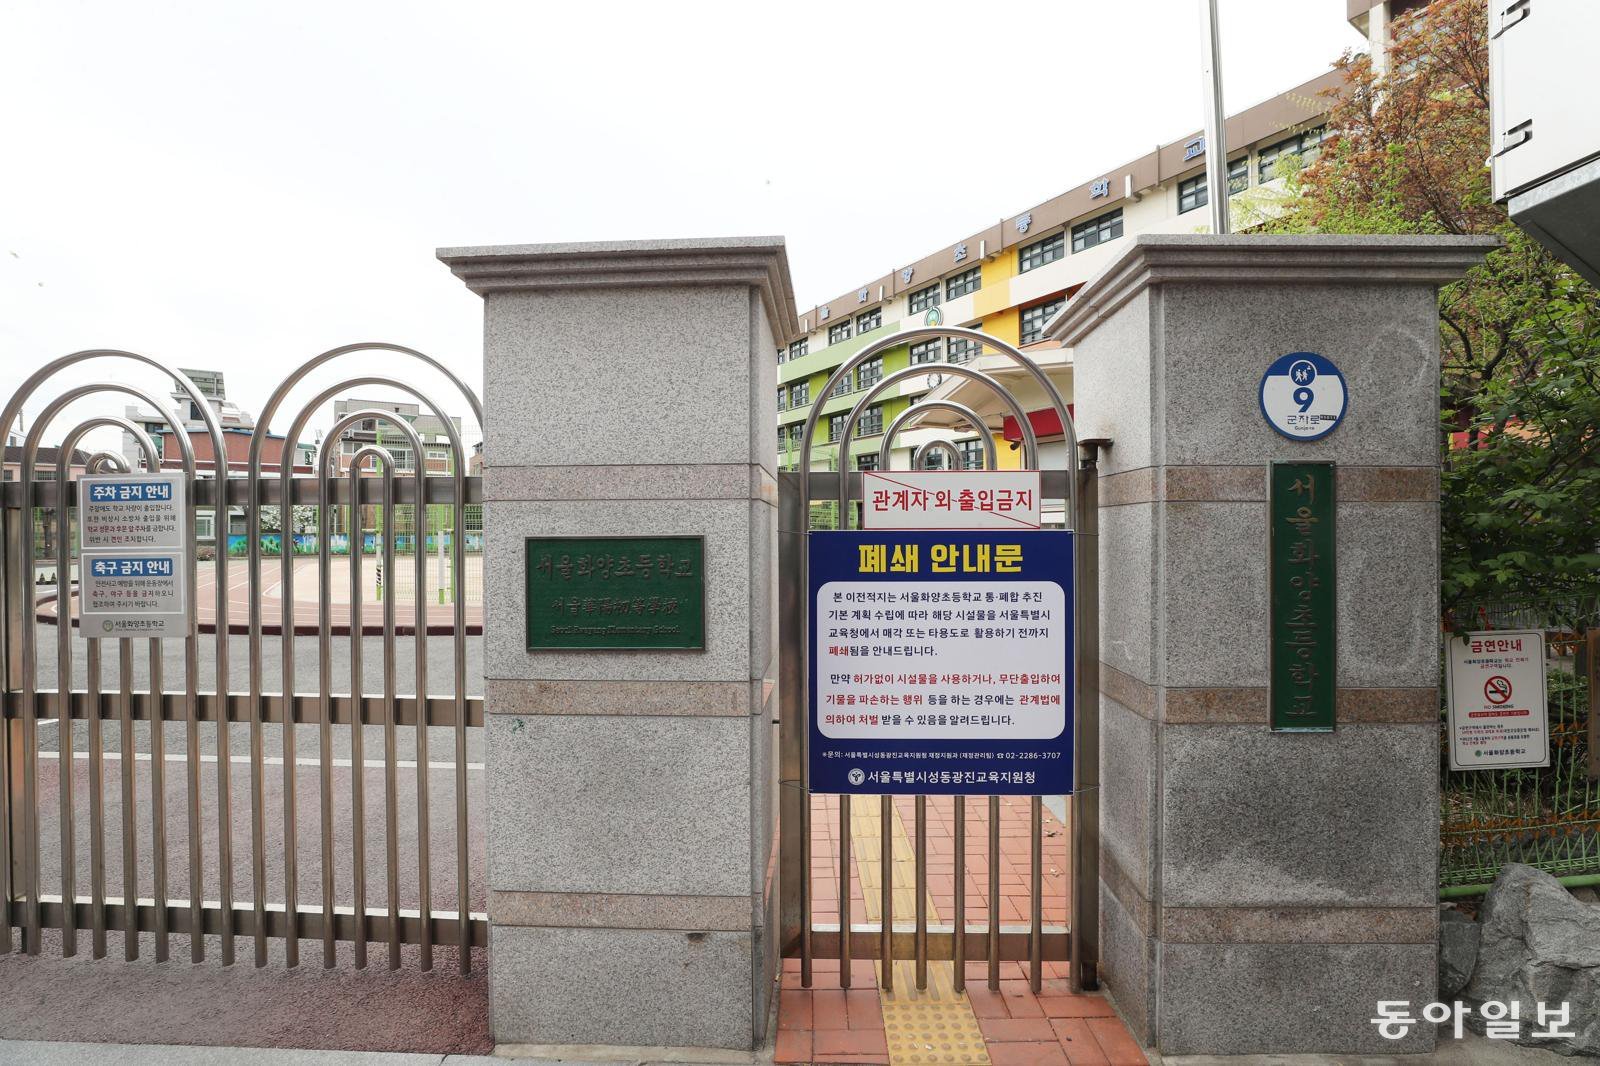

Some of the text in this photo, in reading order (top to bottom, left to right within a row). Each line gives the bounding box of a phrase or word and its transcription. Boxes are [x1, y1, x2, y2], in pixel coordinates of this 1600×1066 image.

[1293, 387, 1314, 412] 9
[1287, 415, 1320, 425] 군자로
[94, 485, 168, 499] 주차 금지 안내
[873, 489, 1031, 511] 관계자 외 출입금지
[858, 544, 1023, 572] 폐쇄 안내문
[95, 561, 169, 574] 축구 금지 안내
[536, 553, 693, 581] 서울화양초등학교
[833, 591, 1041, 603] 본 이전적지는 서울화양초등학교 통·폐합 추진
[1285, 473, 1321, 719] 서울화양초등학교
[829, 609, 1049, 620] 기본 계획 수립에 따라 해당 시설물을 서울특별시
[829, 627, 1048, 639] 교육청에서 매각 또는 타용도로 활용하기 전까지
[829, 645, 937, 656] 폐쇄됨을 안내드립니다.
[1471, 639, 1522, 653] 금연안내
[831, 673, 1060, 685] 만약 허가없이 시설물을 사용하거나, 무단출입하여
[827, 694, 1060, 705] 기물을 파손하는 행위 등을 하는 경우에는 관계법에
[826, 714, 1014, 726] 의하여 처벌 받을 수 있음을 알려드립니다.
[1006, 752, 1060, 760] 02-2286-3707
[868, 771, 1034, 783] 서울특별시성동광진교육지원청
